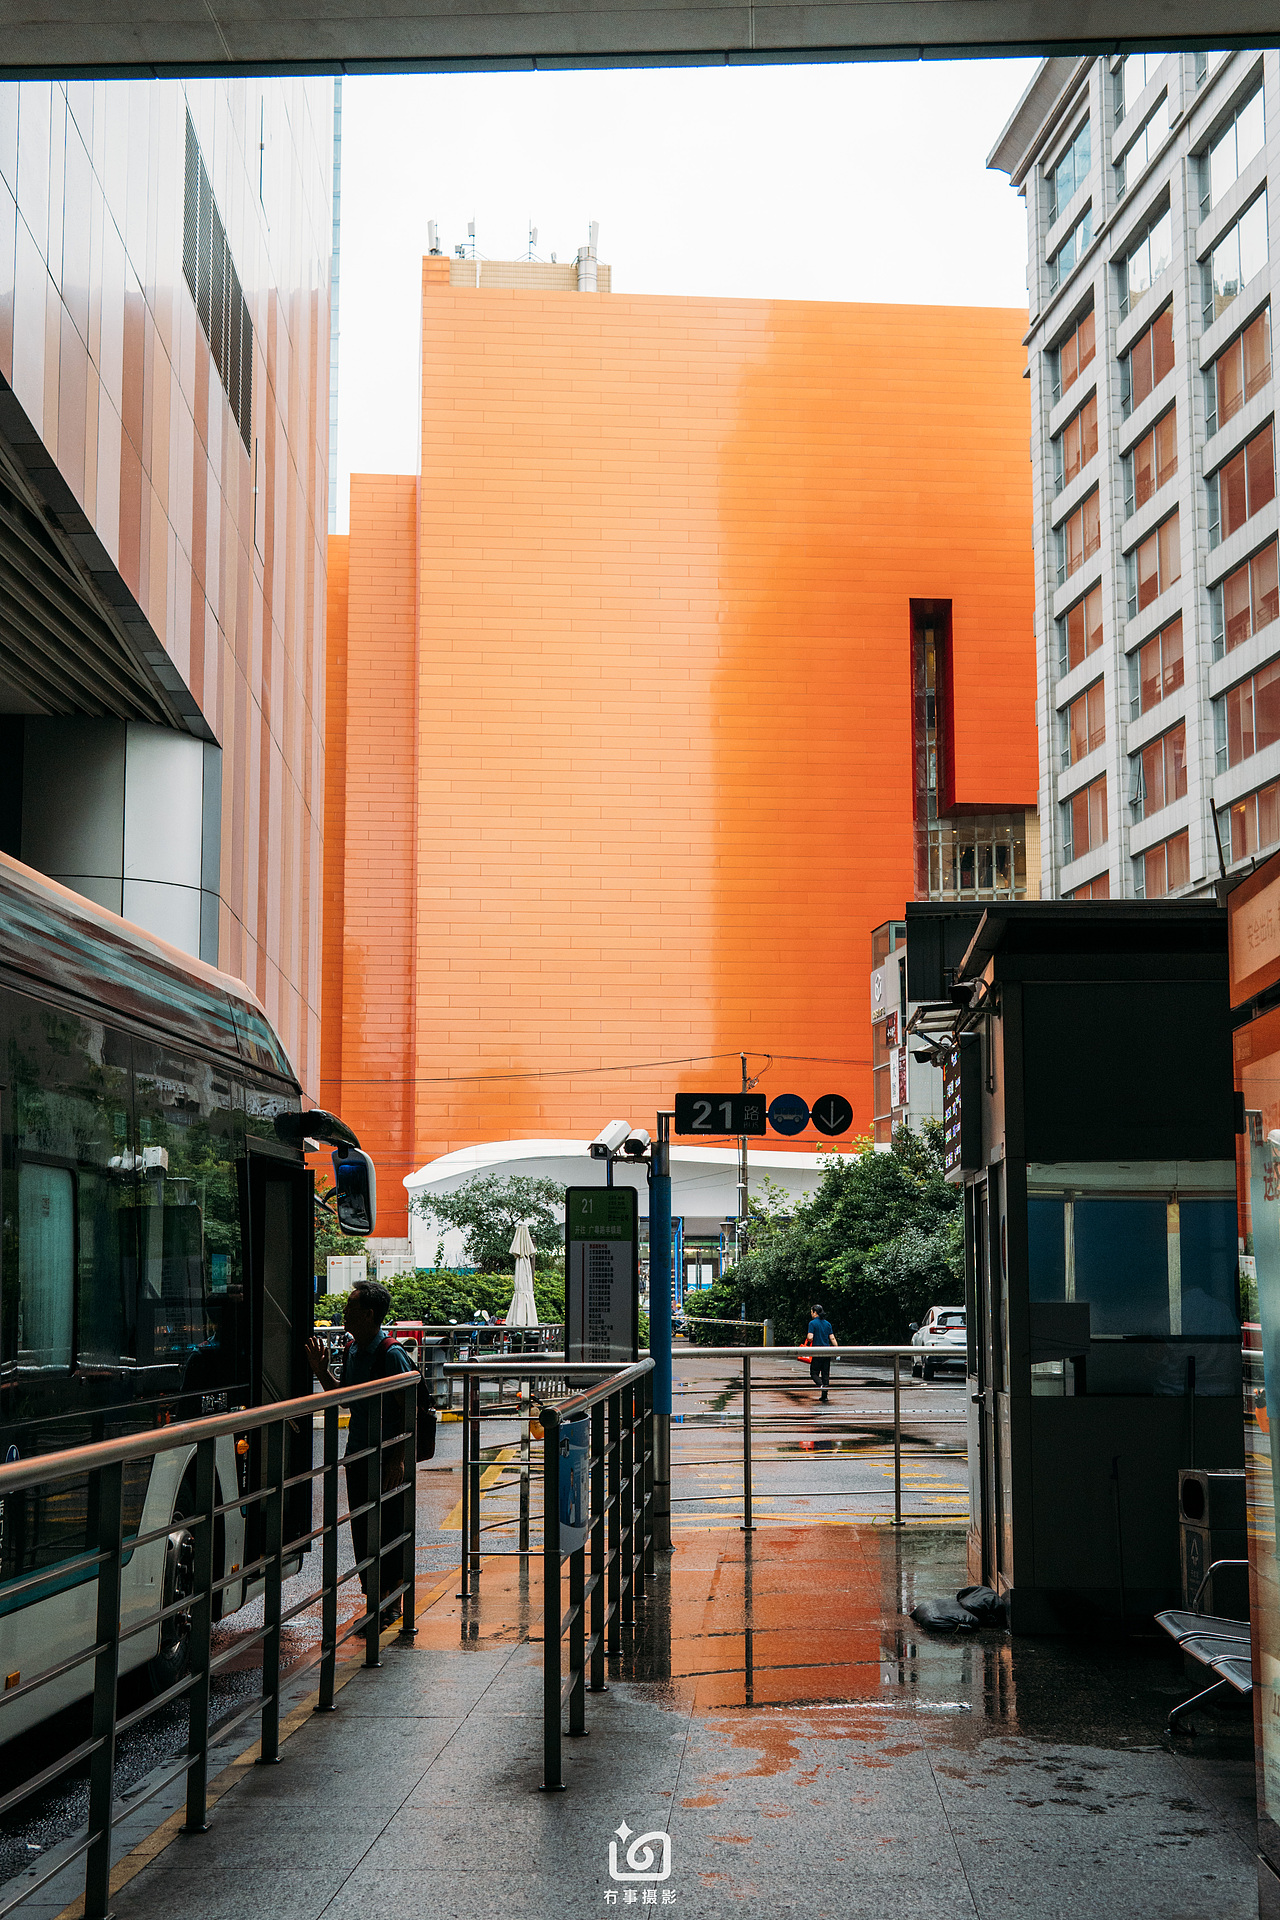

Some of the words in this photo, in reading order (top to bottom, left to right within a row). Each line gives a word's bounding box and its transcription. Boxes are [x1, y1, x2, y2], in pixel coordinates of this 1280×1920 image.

[691, 1100, 732, 1129] 21
[743, 1105, 760, 1121] 路
[581, 1198, 593, 1214] 21
